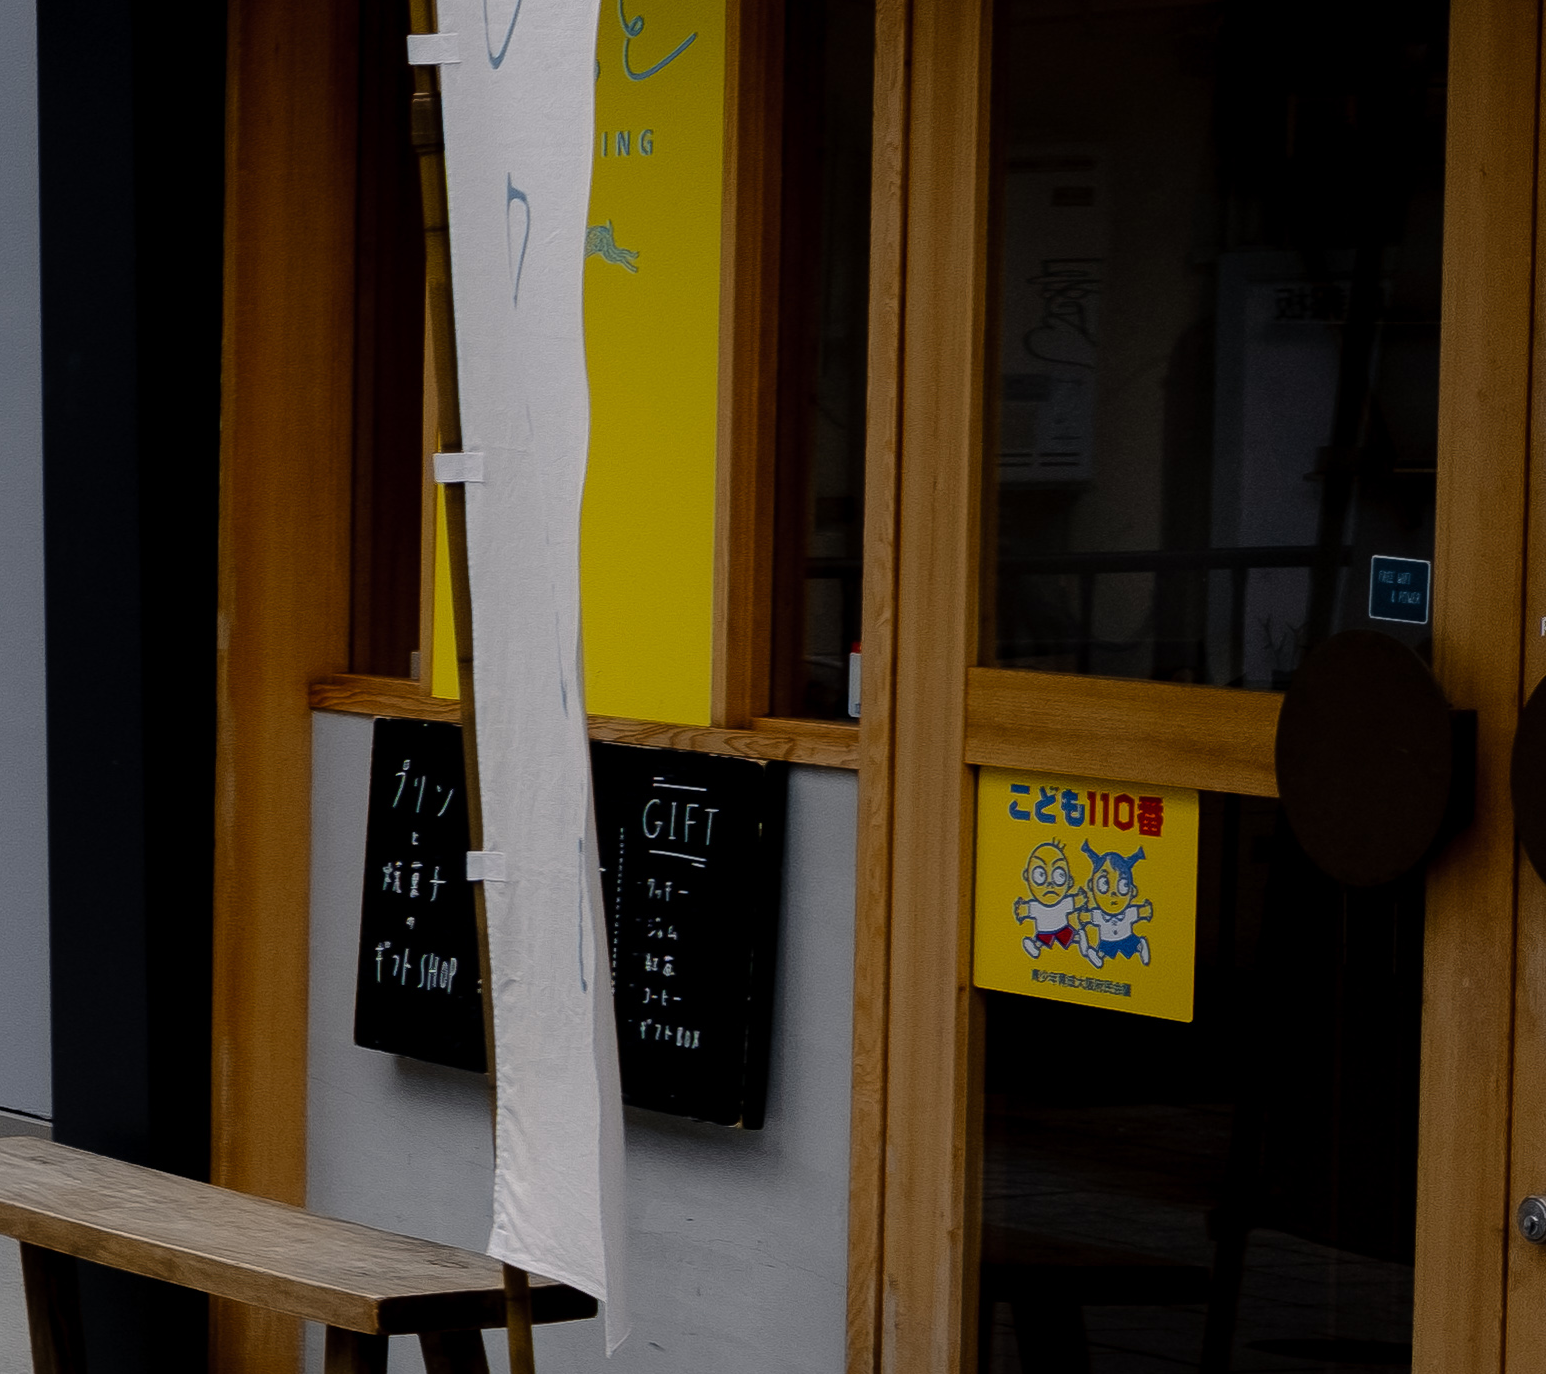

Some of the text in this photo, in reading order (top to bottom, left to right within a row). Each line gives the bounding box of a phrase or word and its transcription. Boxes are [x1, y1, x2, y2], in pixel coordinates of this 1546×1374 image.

[393, 759, 455, 817] プリン
[1008, 783, 1164, 837] こども110番
[642, 798, 719, 846] GIFT
